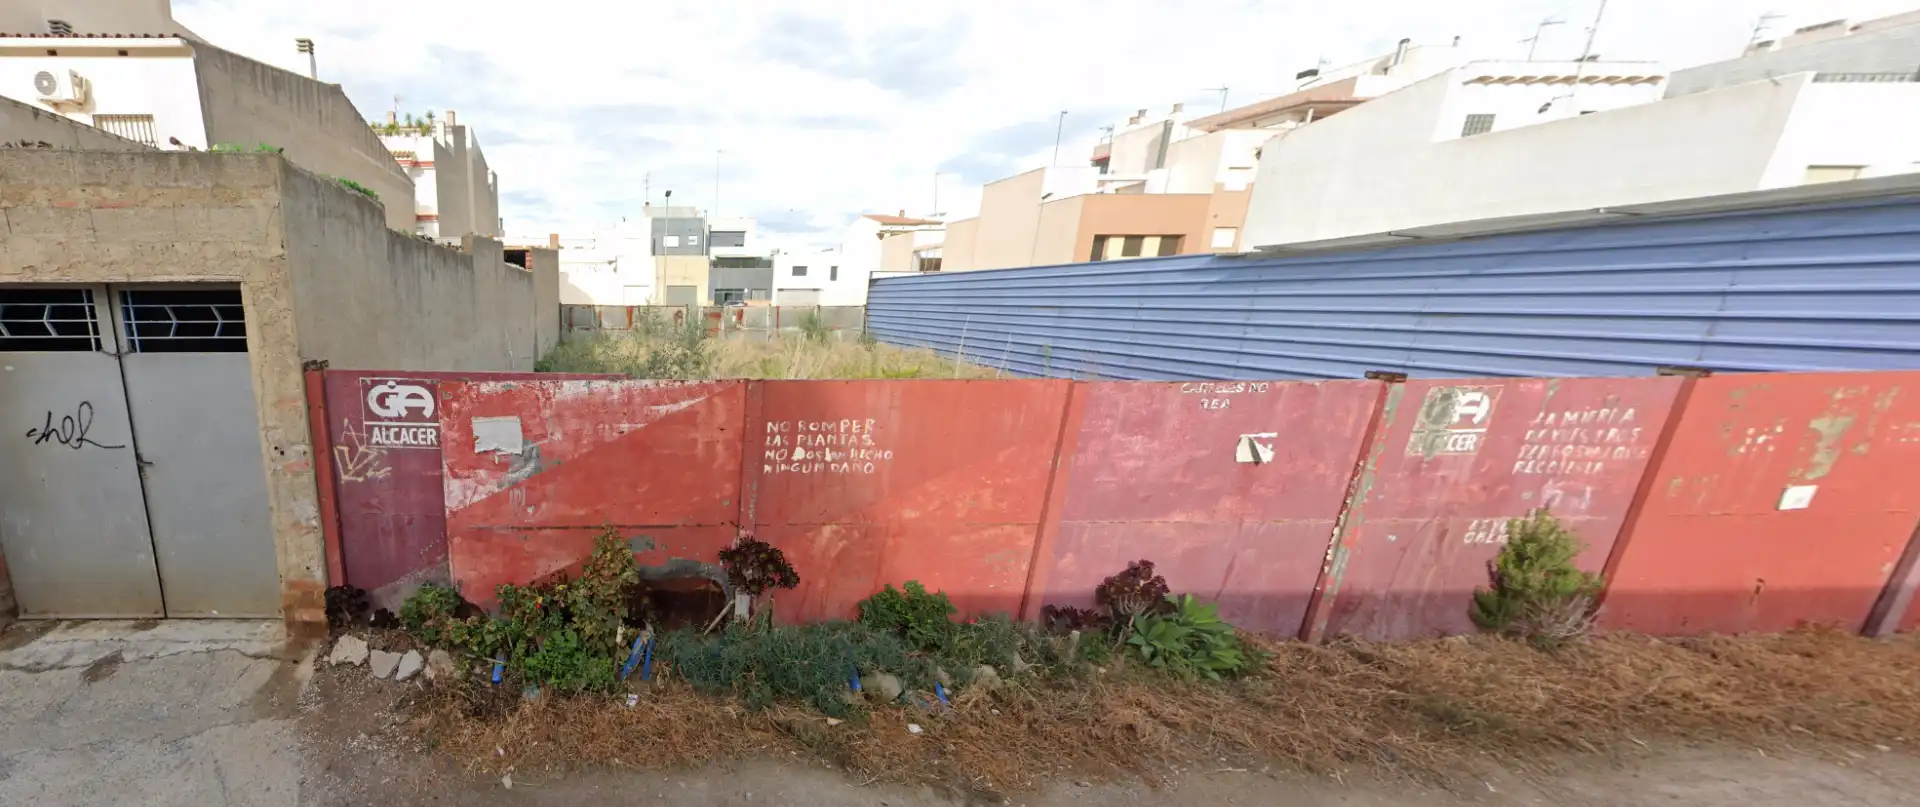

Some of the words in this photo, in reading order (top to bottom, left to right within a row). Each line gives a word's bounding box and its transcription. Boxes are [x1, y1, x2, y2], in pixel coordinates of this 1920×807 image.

[1248, 382, 1269, 394] NO
[767, 420, 791, 434] NO
[798, 418, 876, 434] ROMPER
[371, 427, 437, 446] ALCACER
[765, 434, 789, 447] LAS
[765, 449, 788, 461] NO
